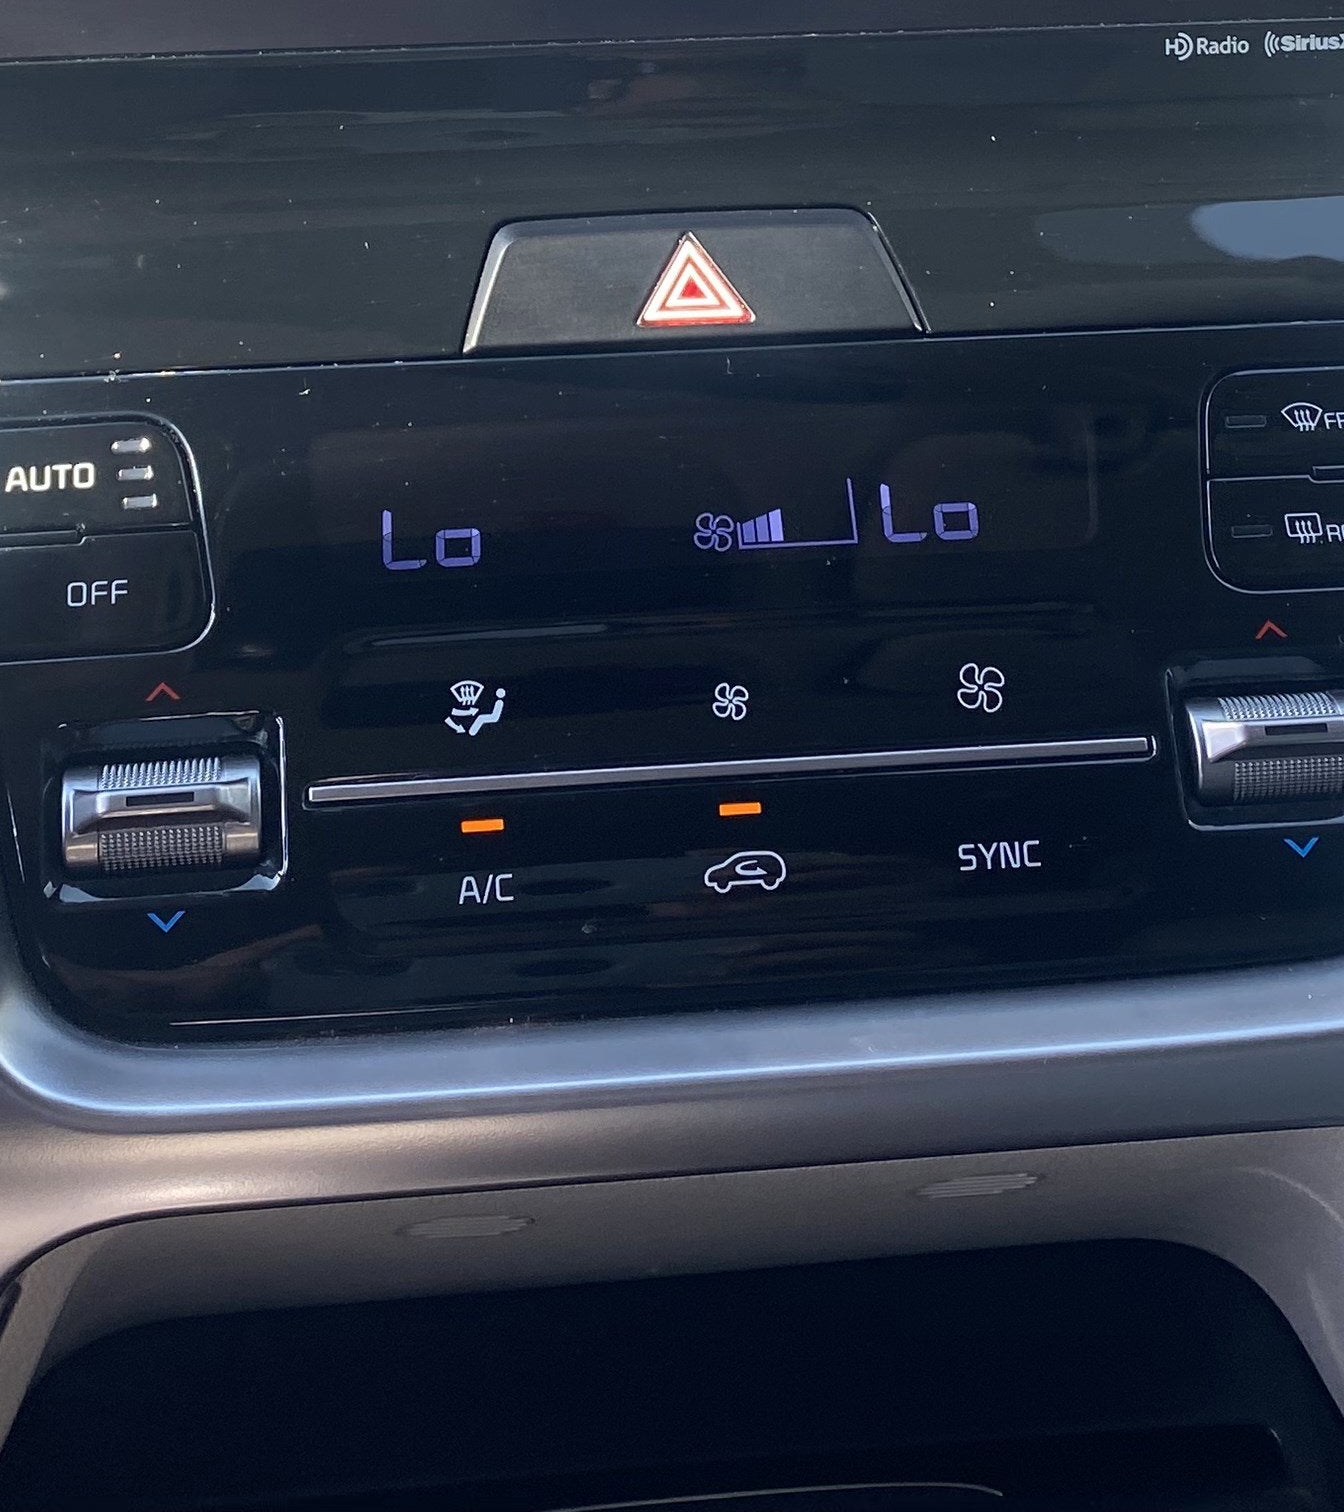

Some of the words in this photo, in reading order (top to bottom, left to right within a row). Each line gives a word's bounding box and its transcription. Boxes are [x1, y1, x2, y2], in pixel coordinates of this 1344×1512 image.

[1165, 32, 1194, 61] HD
[1196, 35, 1250, 55] Radio
[4, 462, 95, 493] AUTO
[879, 483, 979, 543] Lo
[382, 509, 481, 570] Lo
[67, 579, 128, 607] OFF
[957, 839, 1042, 872] SYNC
[458, 873, 514, 905] A/C
